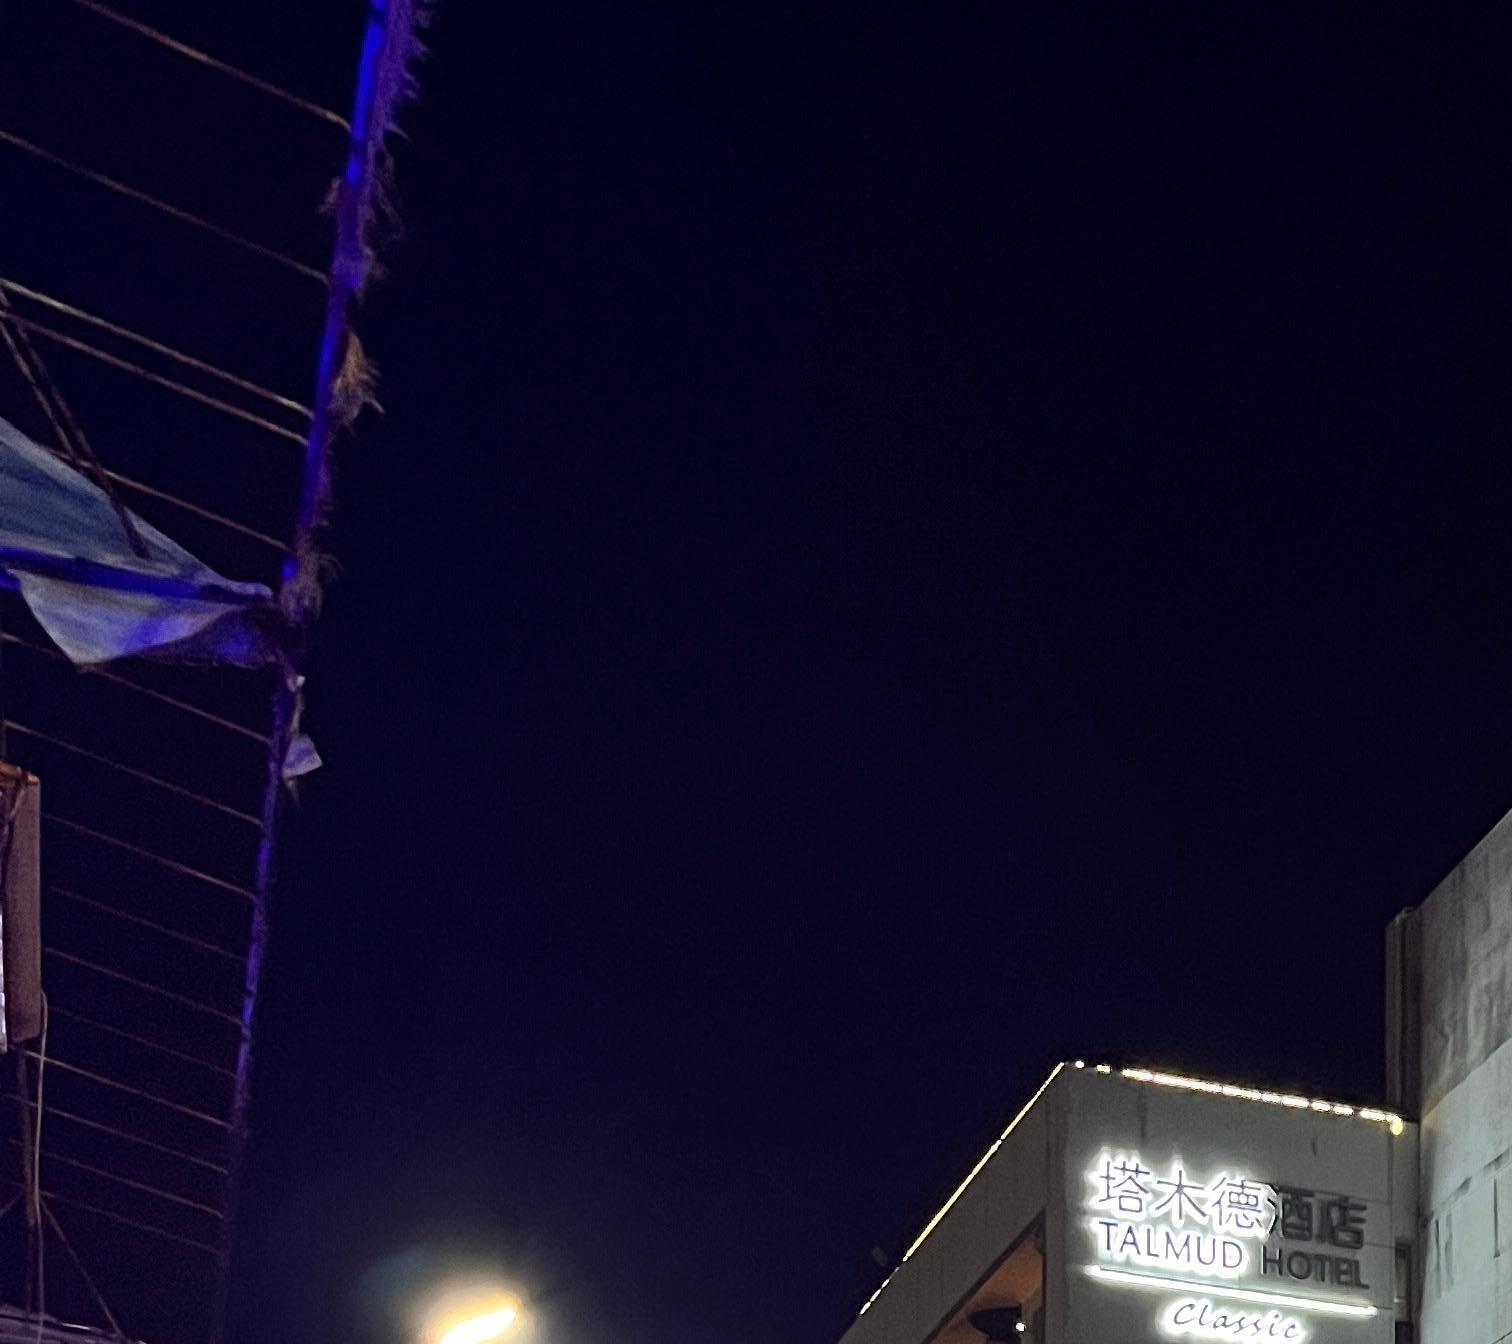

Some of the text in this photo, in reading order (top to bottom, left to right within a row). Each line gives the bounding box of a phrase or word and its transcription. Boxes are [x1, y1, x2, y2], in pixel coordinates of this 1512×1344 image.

[1098, 1159, 1369, 1250] 塔木德酒店
[1098, 1220, 1370, 1289] TALMUD HOTEL
[1173, 1302, 1301, 1341] Classic
